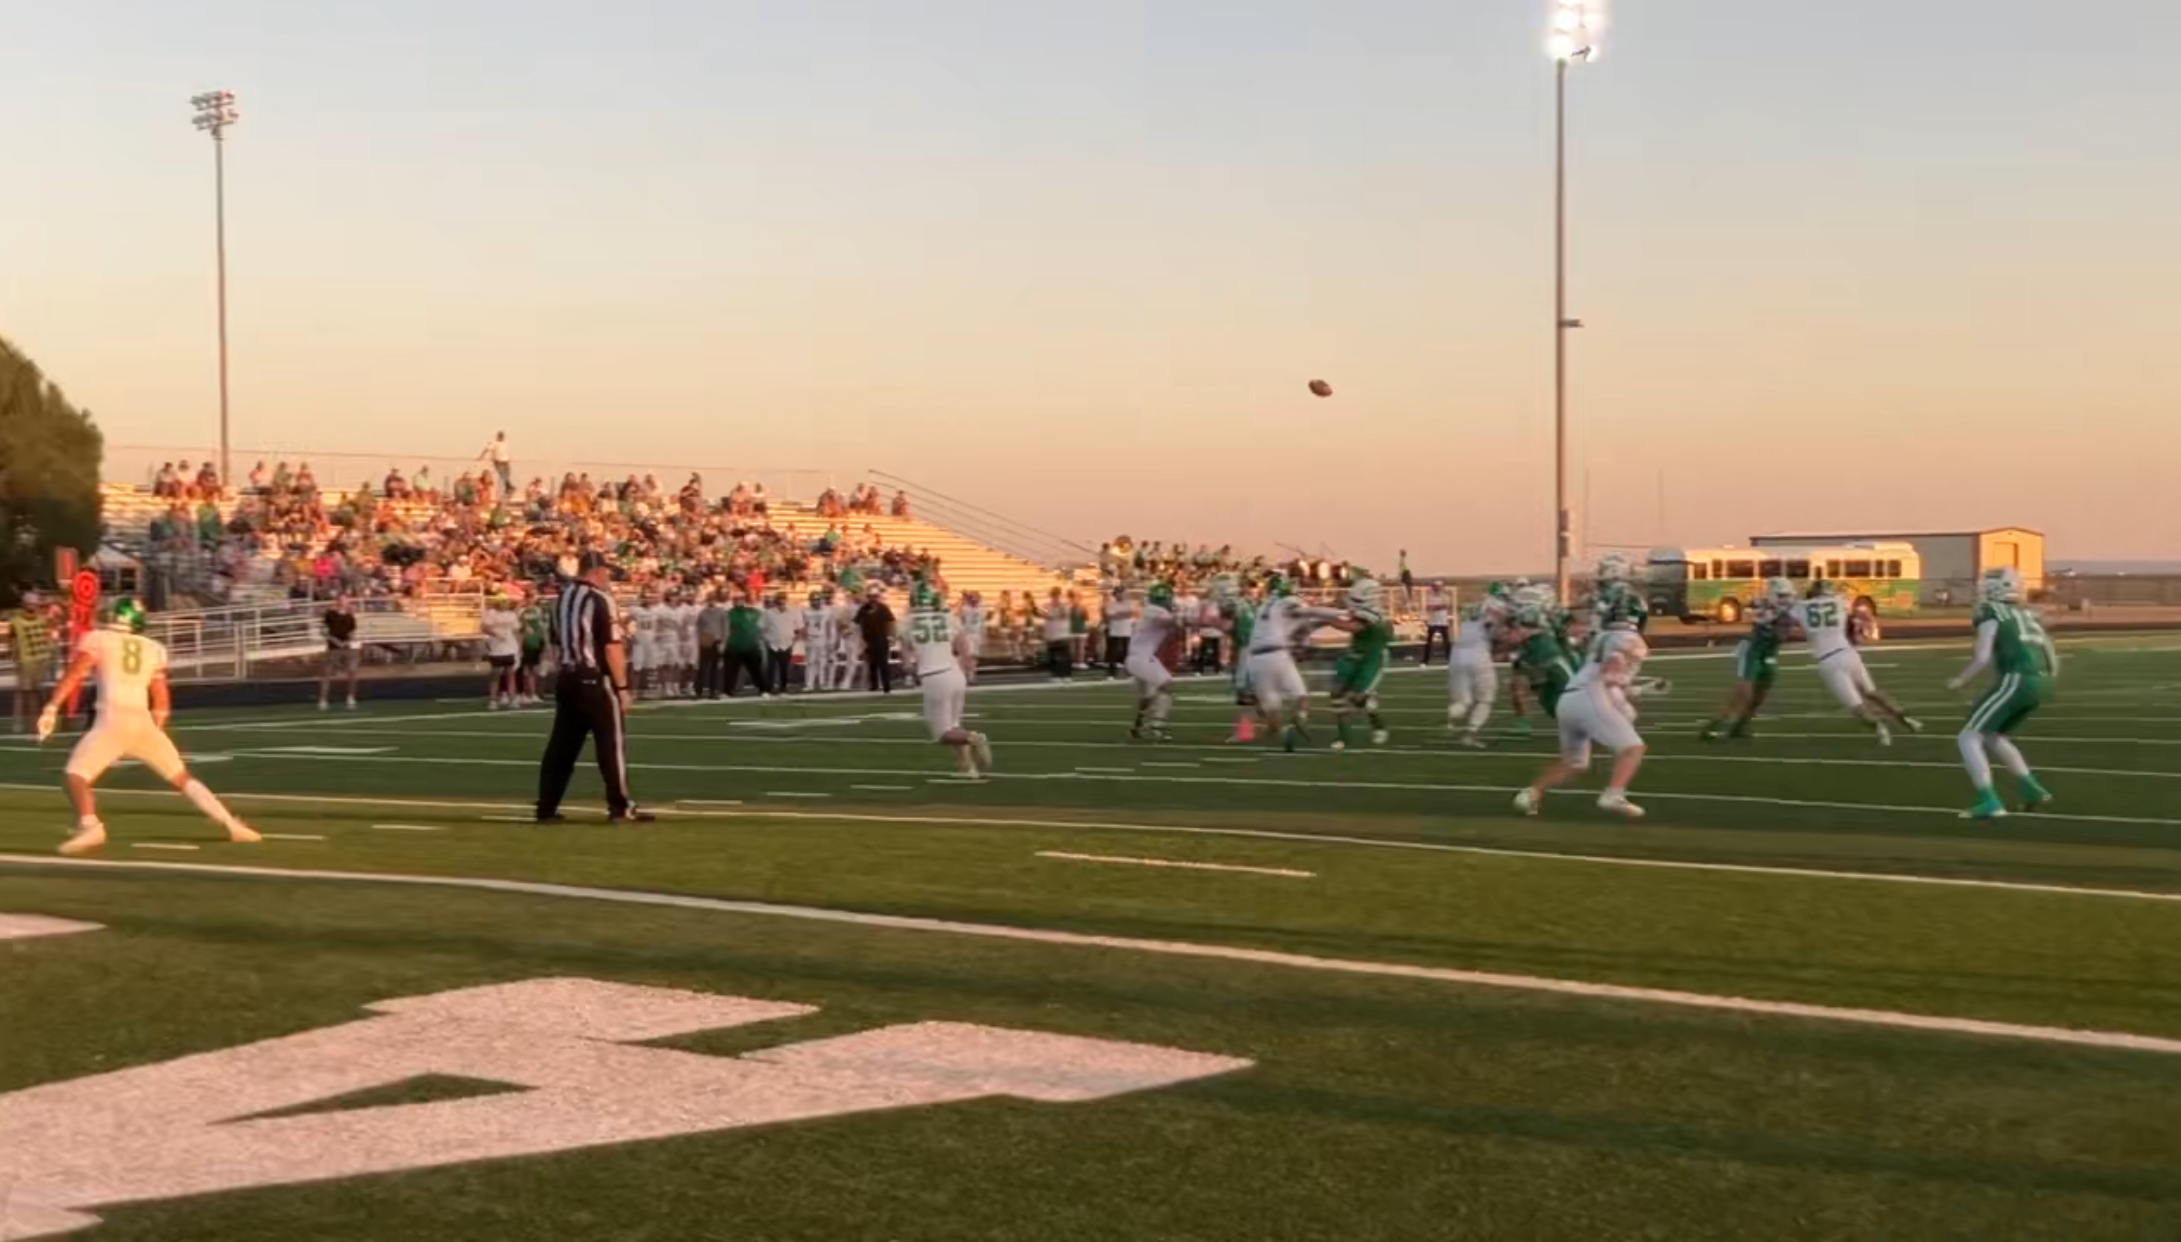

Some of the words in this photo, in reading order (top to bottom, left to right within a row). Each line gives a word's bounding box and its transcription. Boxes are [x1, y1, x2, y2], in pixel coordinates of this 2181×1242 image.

[912, 615, 949, 643] 52
[1806, 602, 1838, 628] 62
[122, 639, 142, 675] 8
